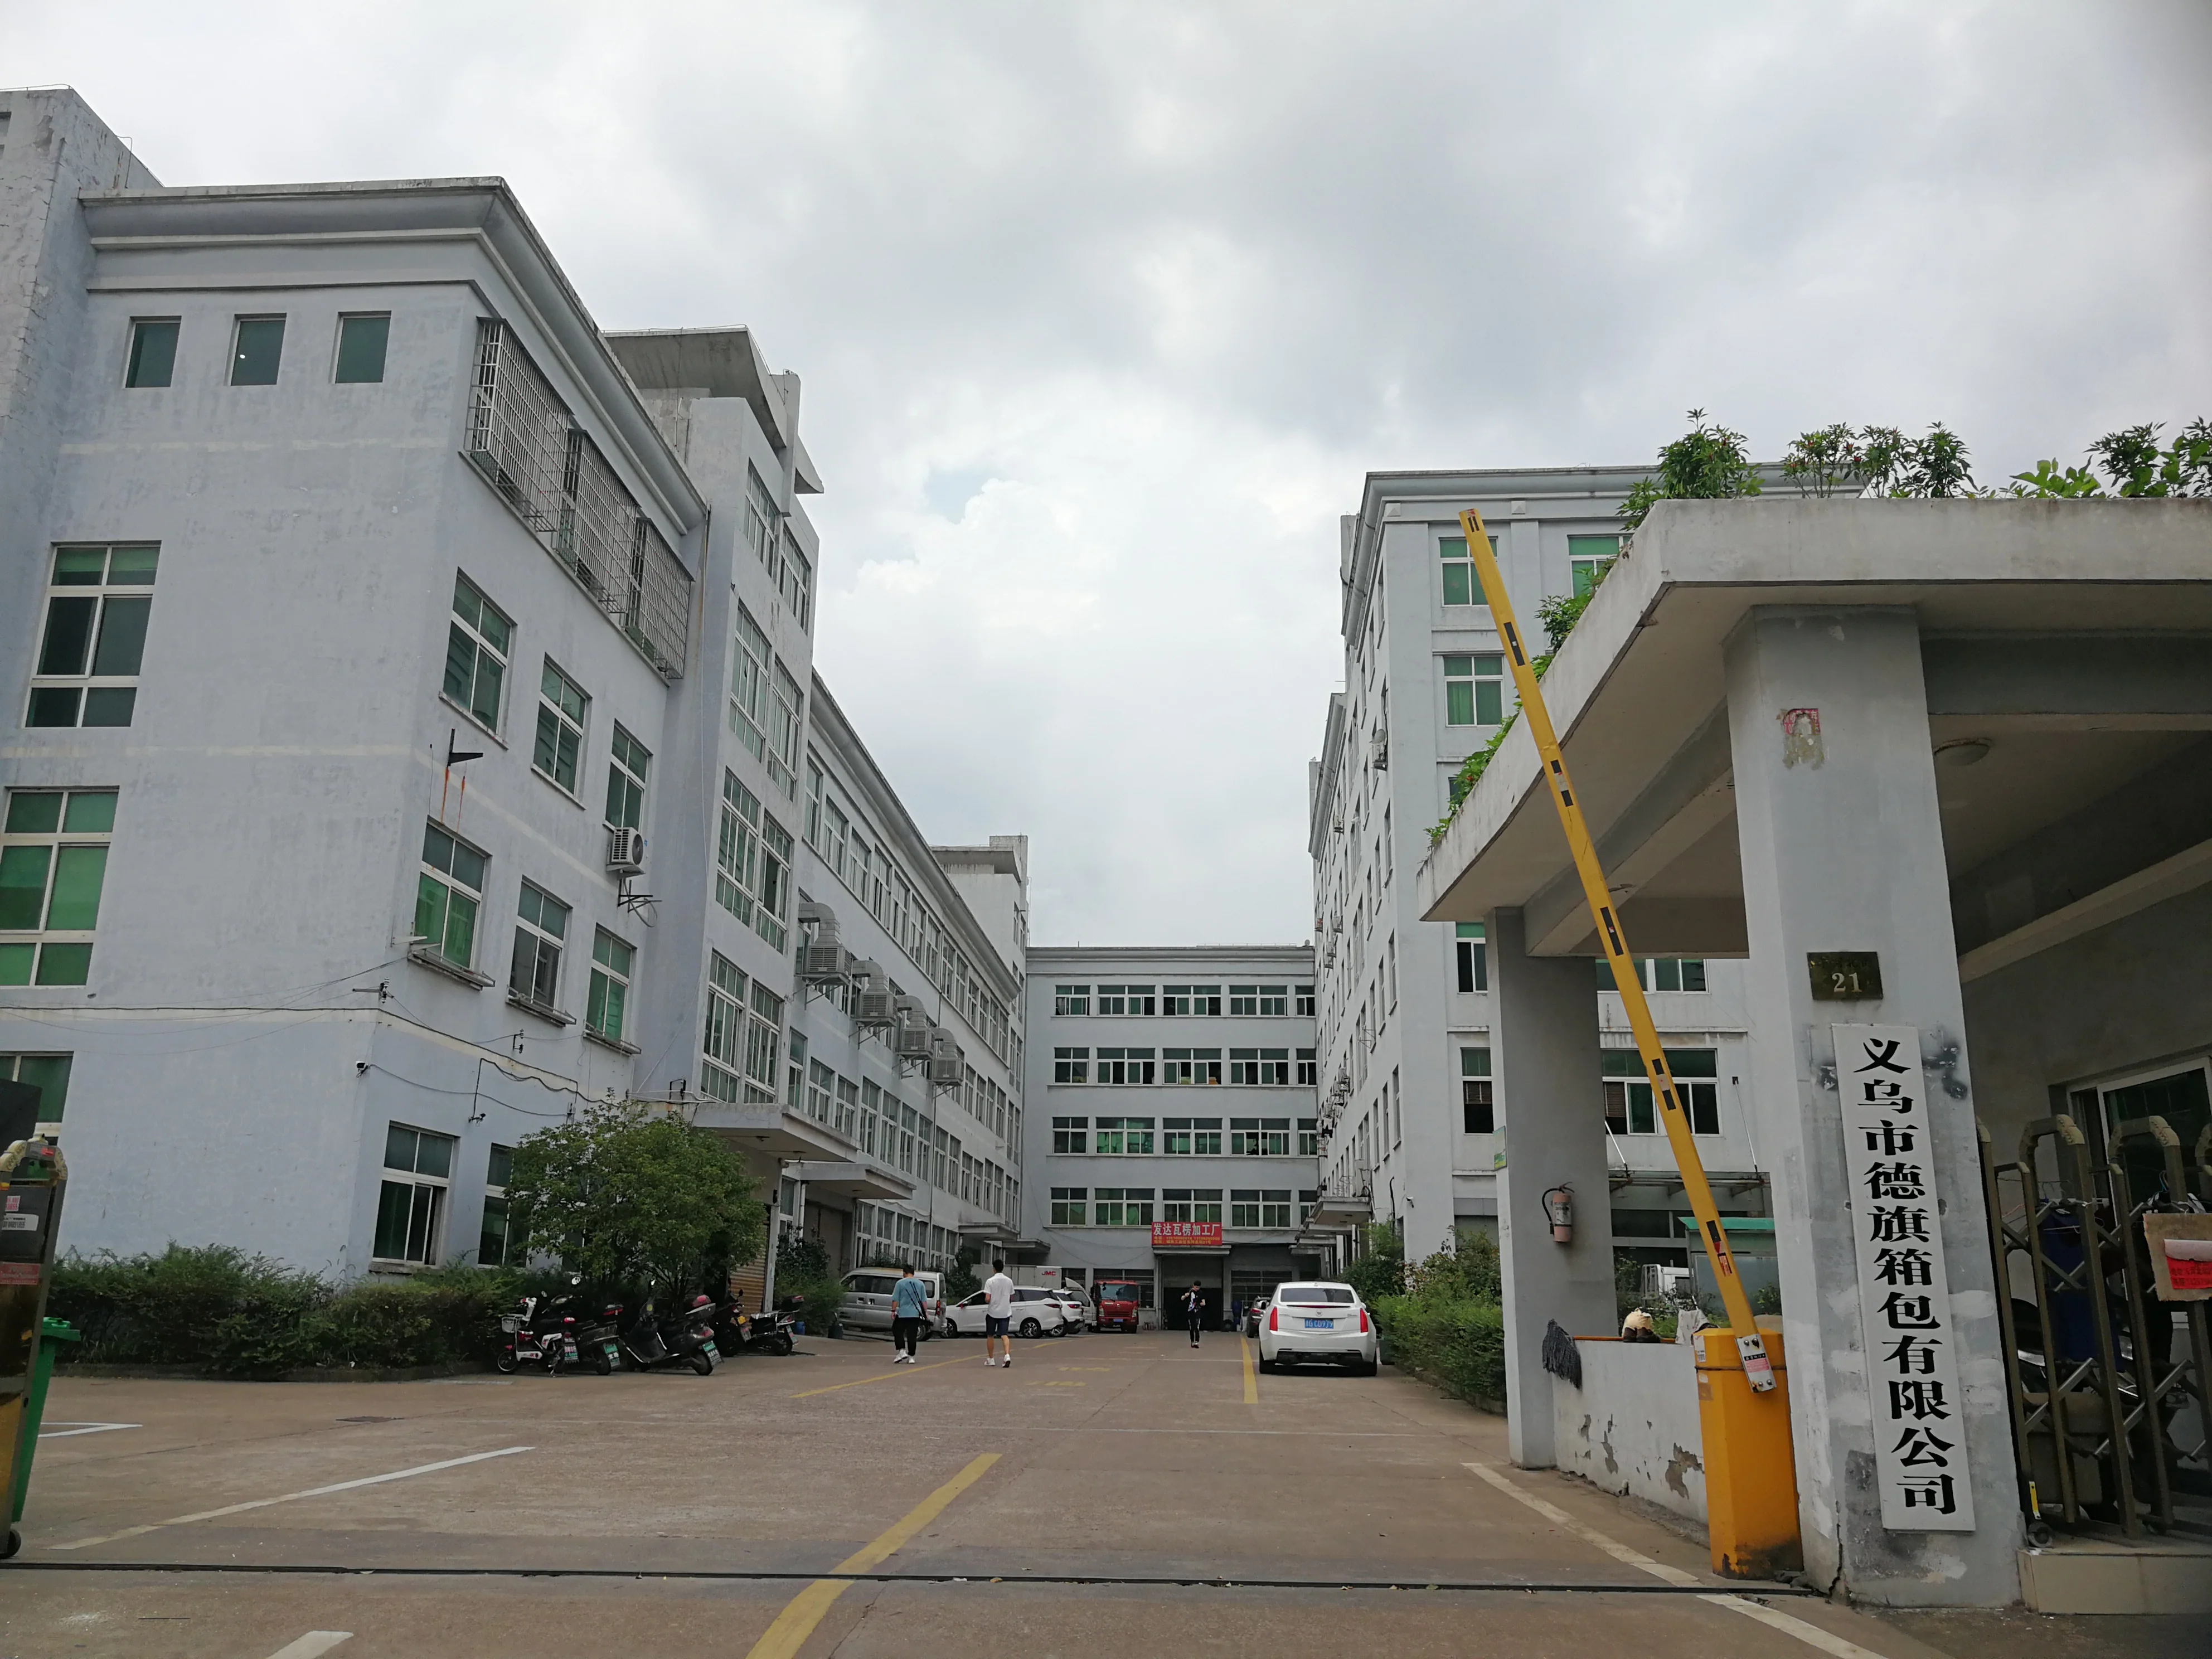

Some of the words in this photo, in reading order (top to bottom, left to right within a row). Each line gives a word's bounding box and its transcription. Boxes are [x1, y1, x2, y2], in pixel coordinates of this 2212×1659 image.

[1832, 972, 1862, 992] 21
[1153, 1223, 1220, 1236] 发达瓦楞加工厂
[1853, 1037, 1957, 1515] 义乌市德旗箱包有限公司
